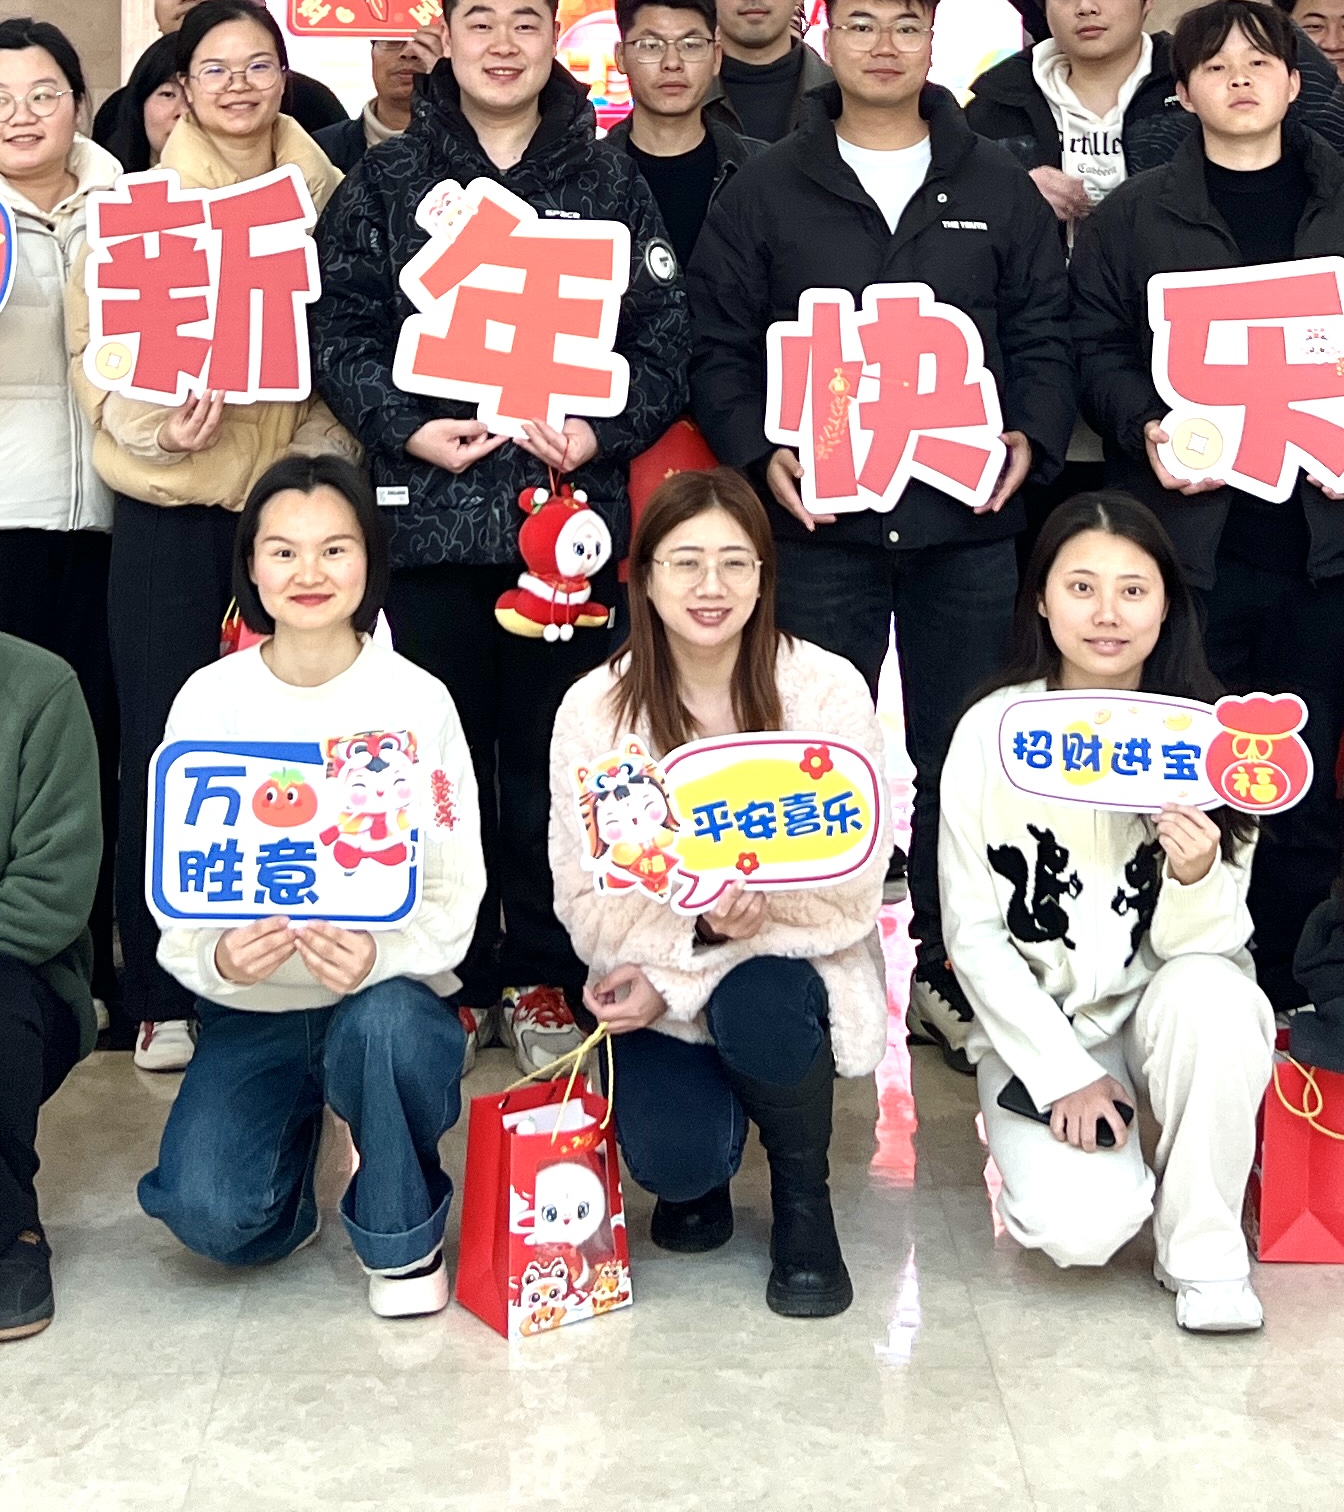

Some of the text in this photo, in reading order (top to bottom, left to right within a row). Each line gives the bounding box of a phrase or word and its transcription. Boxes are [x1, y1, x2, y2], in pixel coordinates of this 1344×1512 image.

[97, 174, 310, 394] 新
[411, 194, 614, 420] 年
[779, 297, 991, 499] 快
[1012, 729, 1201, 782] 招财进宝
[1233, 769, 1277, 800] 福
[184, 766, 246, 827] 万
[691, 790, 863, 845] 平安喜乐
[178, 838, 320, 905] 胜意
